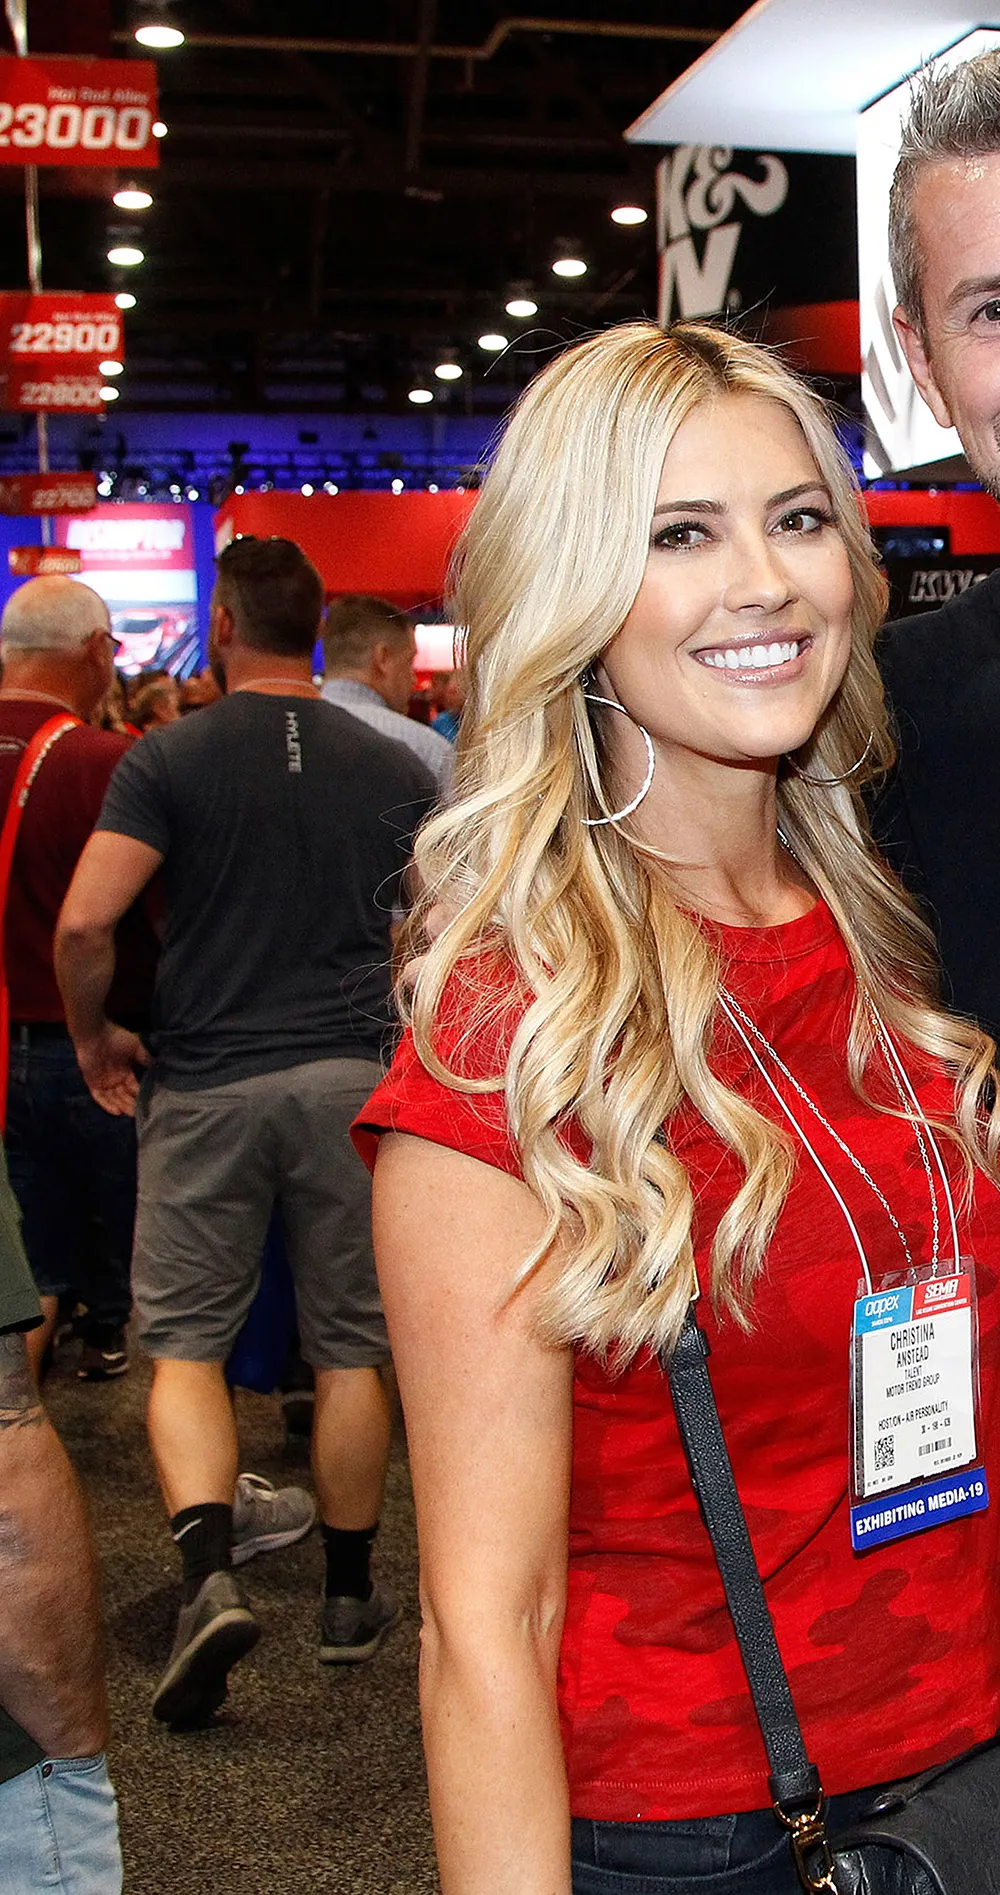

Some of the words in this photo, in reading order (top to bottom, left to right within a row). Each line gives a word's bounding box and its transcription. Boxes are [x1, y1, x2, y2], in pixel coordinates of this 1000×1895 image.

[0, 102, 151, 150] 23000
[10, 322, 120, 353] 22900
[925, 1278, 959, 1299] SEMA
[890, 1322, 935, 1351] CHRISTINA
[896, 1345, 930, 1369] ANSTEAD
[855, 1499, 926, 1536] EXHIBITING
